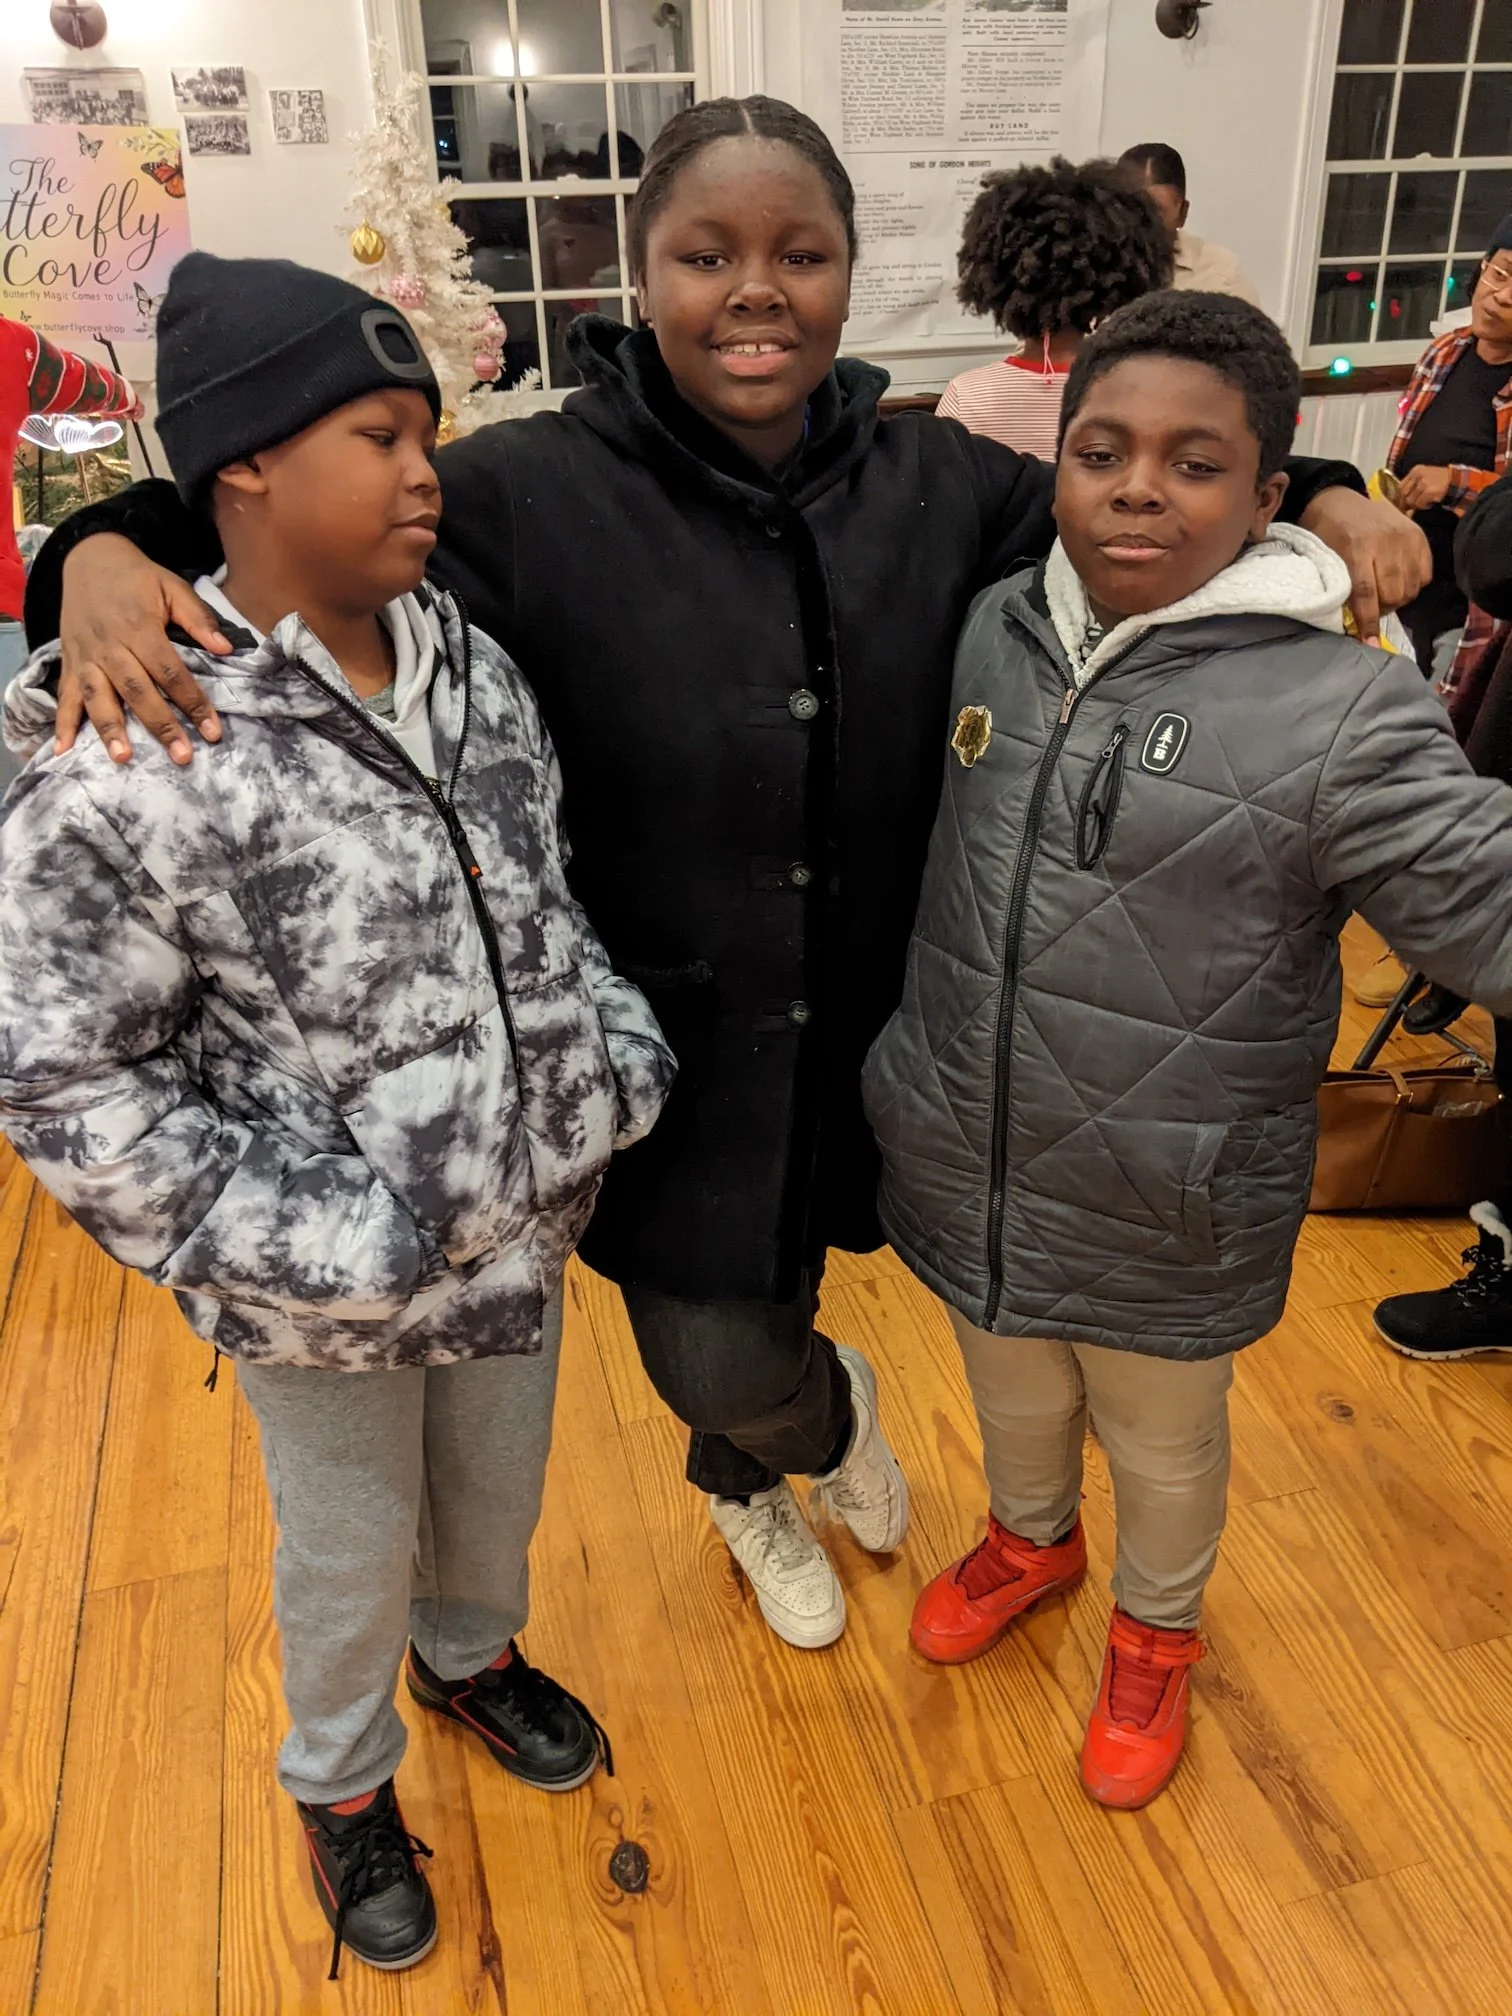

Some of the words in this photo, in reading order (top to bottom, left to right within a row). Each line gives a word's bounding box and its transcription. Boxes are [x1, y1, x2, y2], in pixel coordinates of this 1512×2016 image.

[9, 157, 75, 195] The
[909, 161, 926, 169] SONG
[939, 160, 965, 168] GORDON
[0, 178, 169, 271] tterfly
[3, 244, 122, 287] Cove
[3, 289, 40, 300] Butterfly
[43, 290, 69, 301] Magic
[72, 291, 100, 301] Comes
[104, 292, 114, 301] to
[117, 293, 134, 301] Life
[1153, 747, 1166, 760] B
